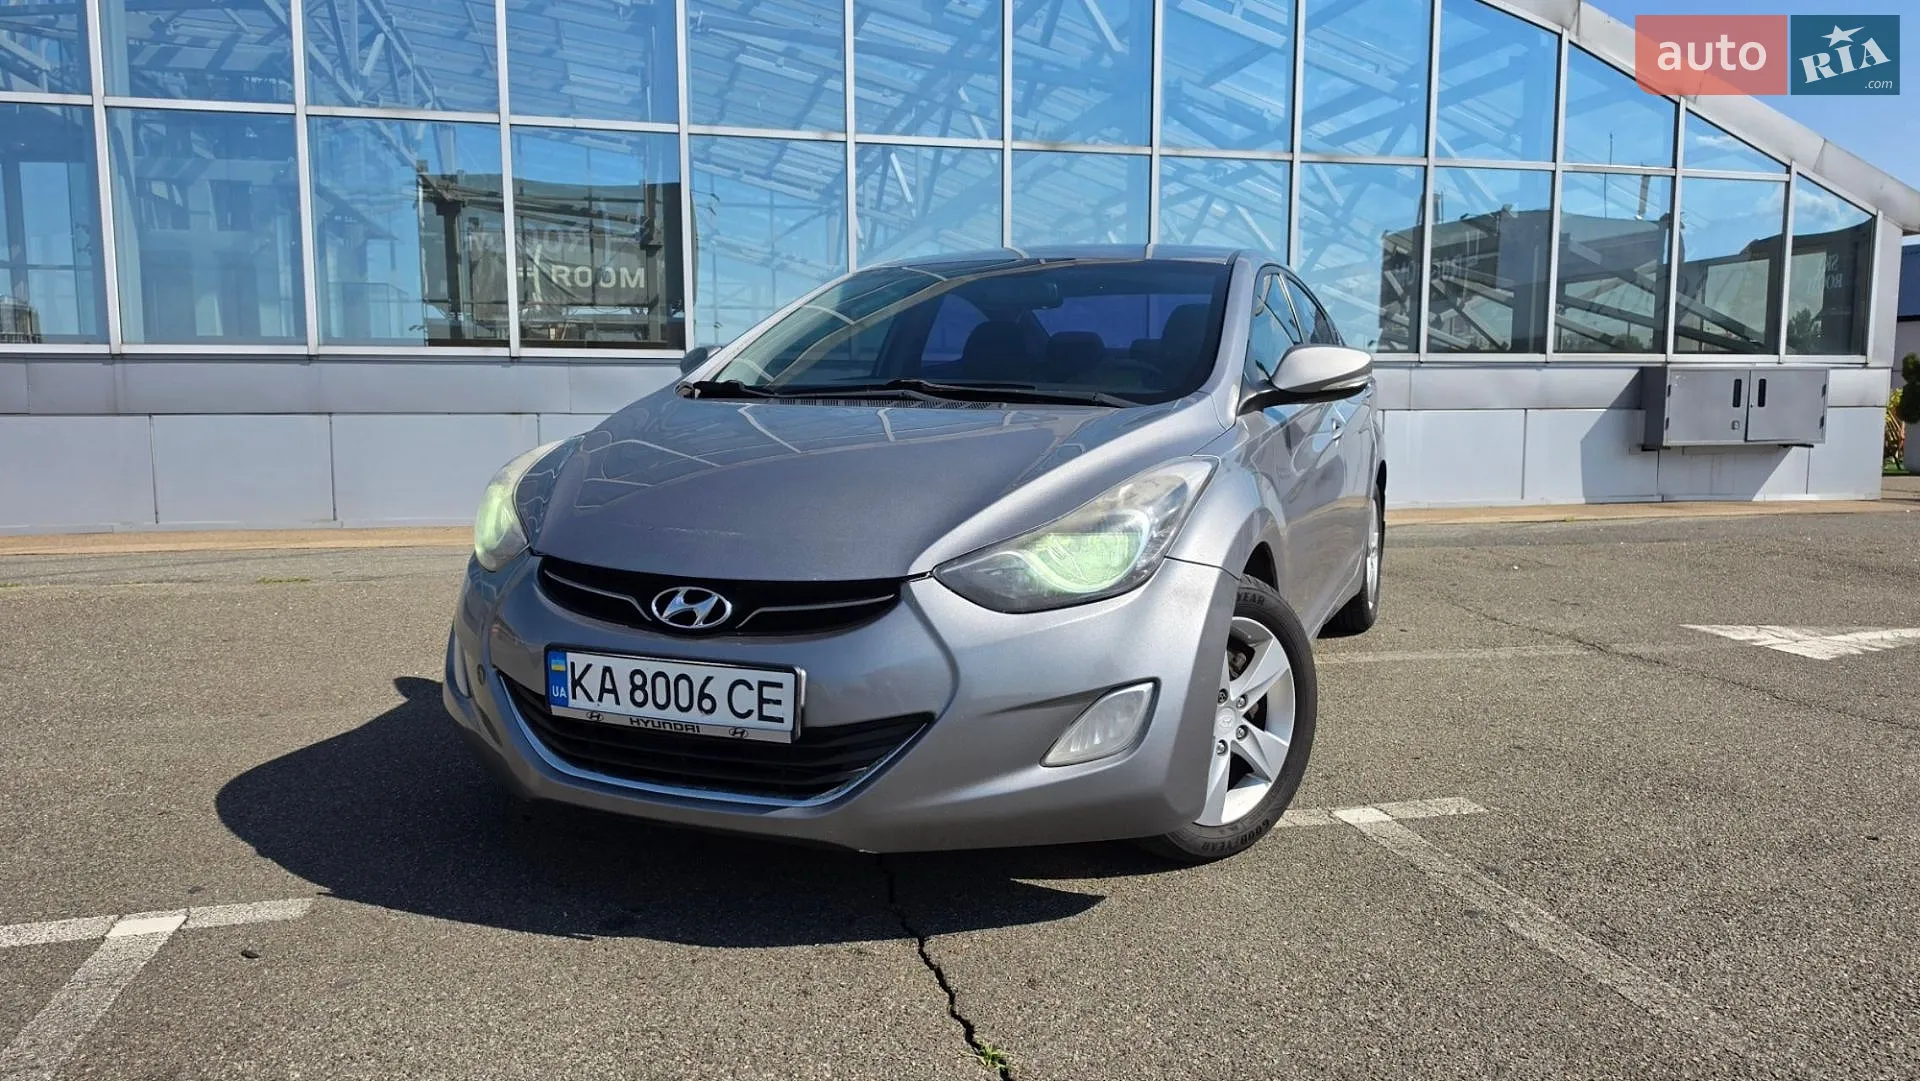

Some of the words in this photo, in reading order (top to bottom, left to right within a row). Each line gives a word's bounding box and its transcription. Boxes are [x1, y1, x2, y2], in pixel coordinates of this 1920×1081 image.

[551, 264, 645, 288] ROOM
[552, 684, 568, 699] UA
[570, 661, 620, 706] KA
[629, 668, 717, 715] 8006
[727, 679, 784, 724] CE
[629, 717, 701, 734] HYUNDAI
